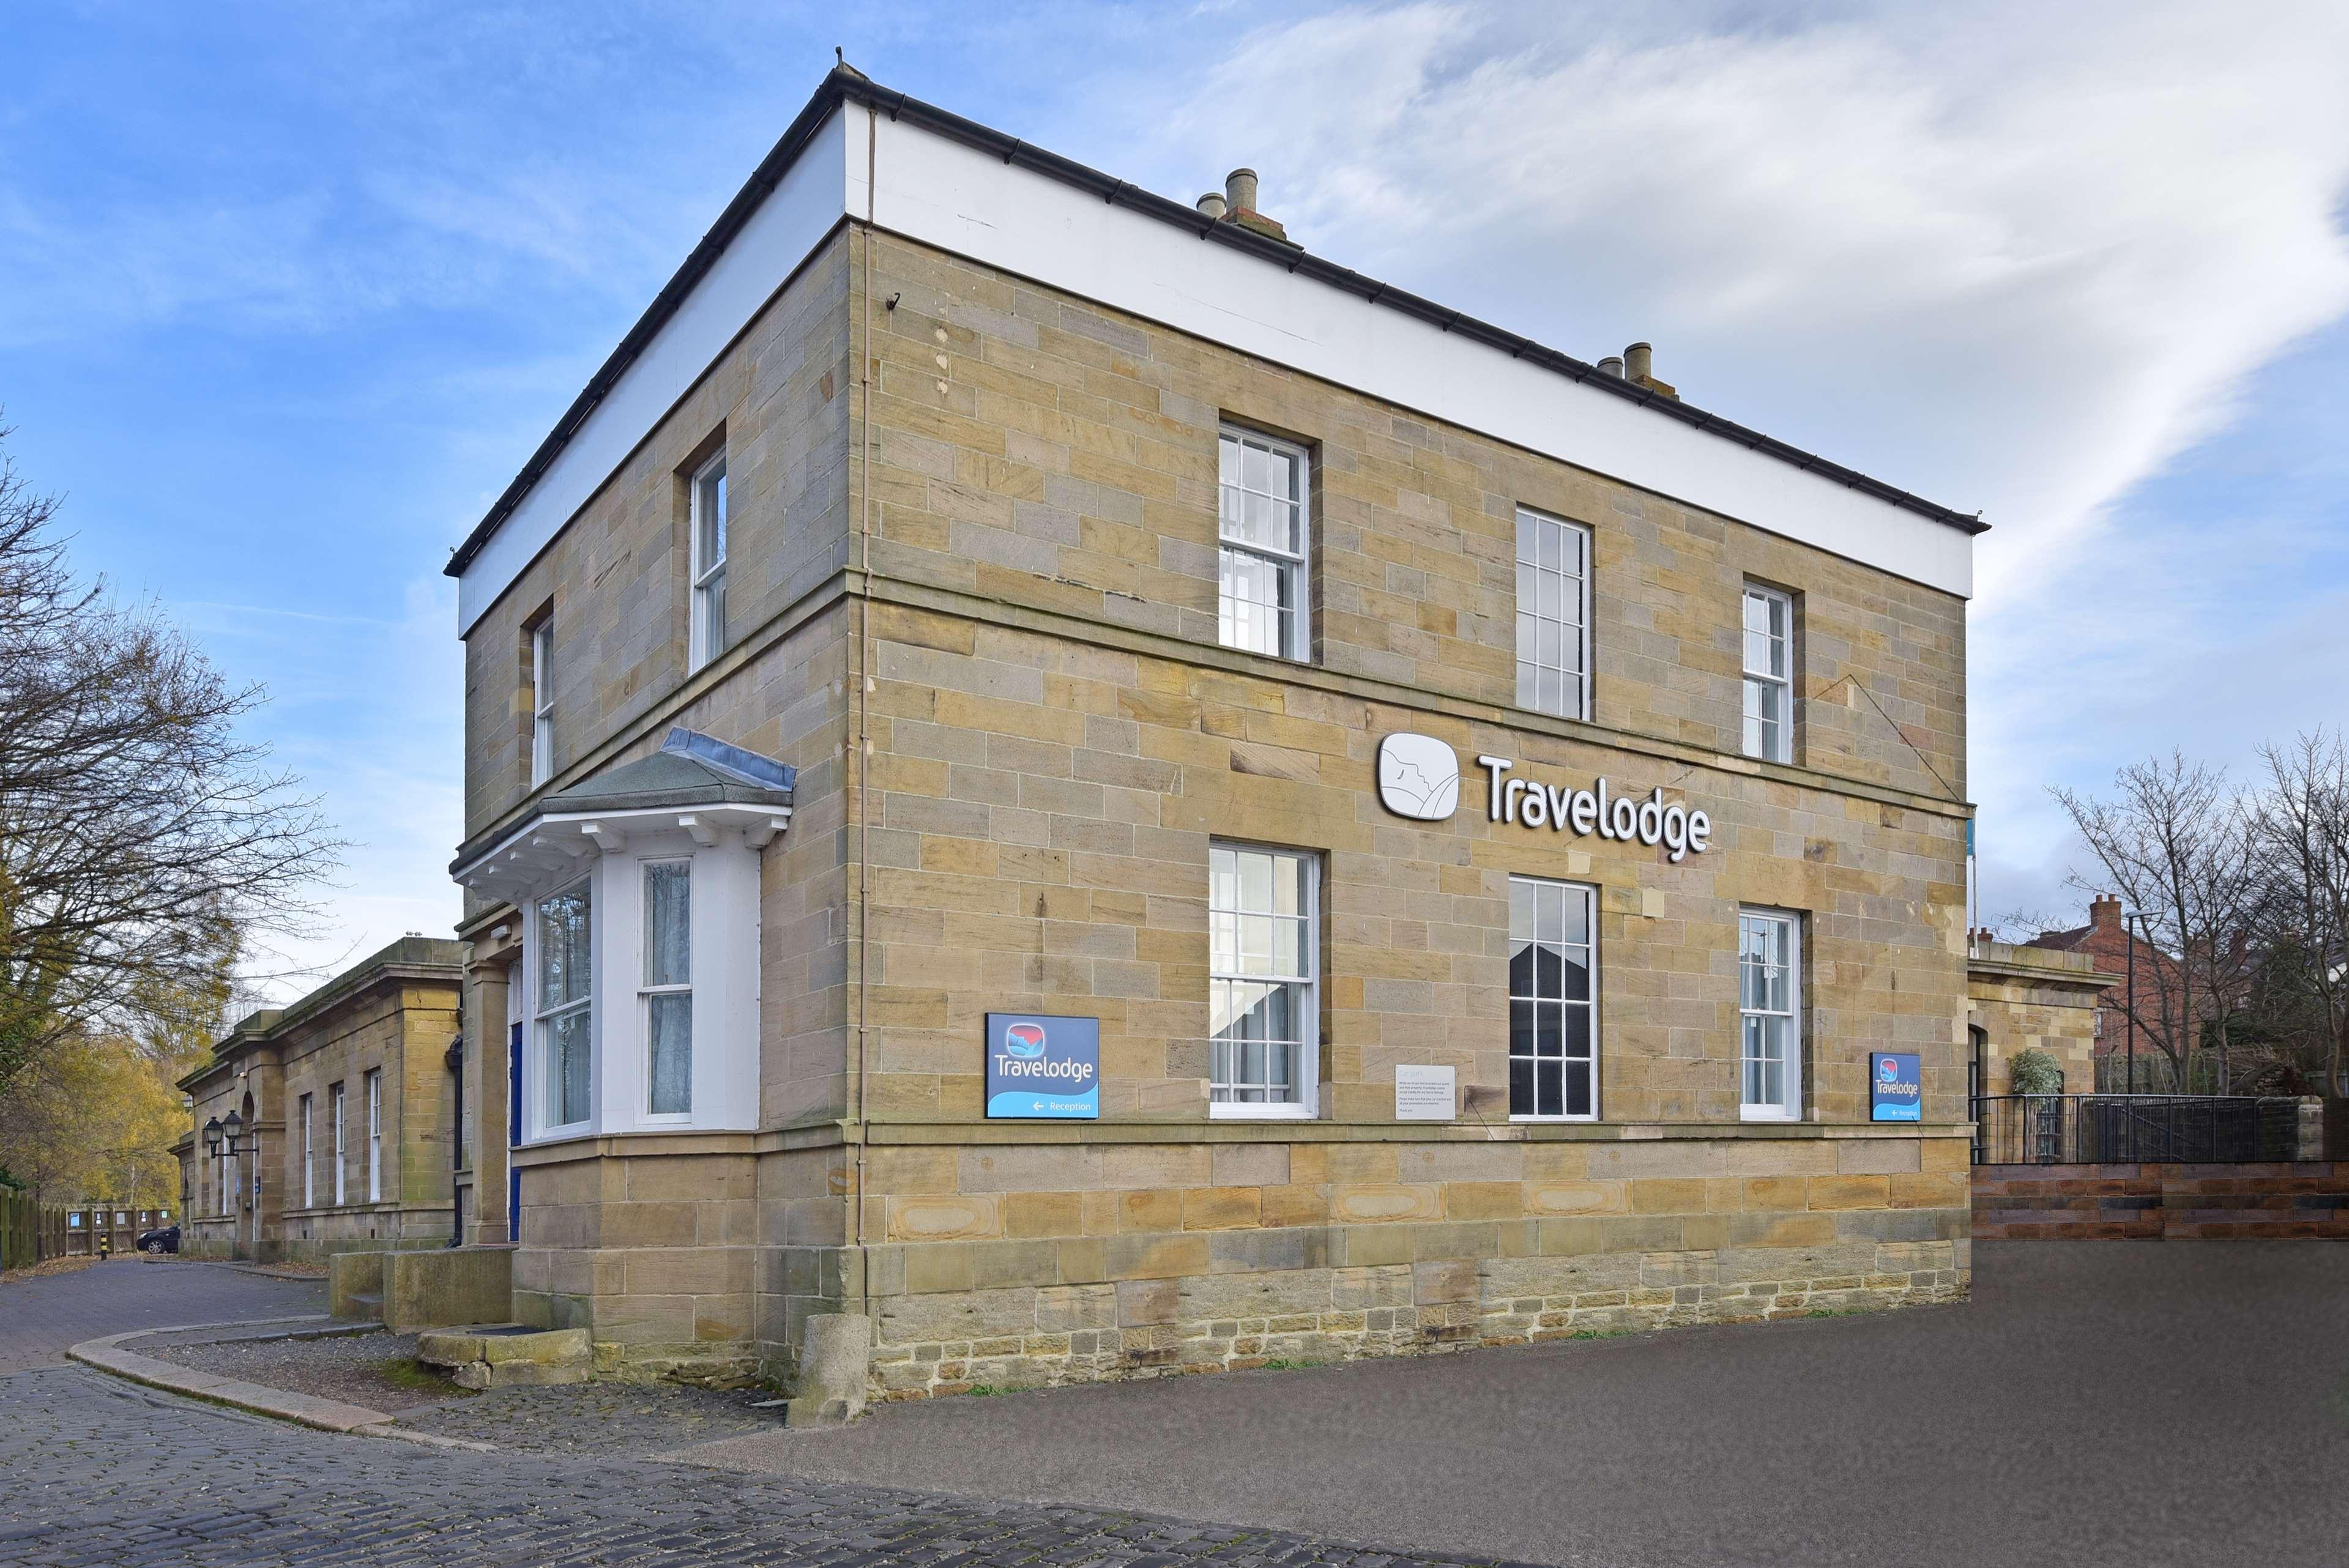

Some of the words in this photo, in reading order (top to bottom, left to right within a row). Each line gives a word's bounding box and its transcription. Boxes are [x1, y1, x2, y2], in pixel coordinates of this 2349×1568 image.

[1478, 755, 1711, 863] Travelodge
[994, 1055, 1093, 1083] Travelodge
[1875, 1080, 1918, 1098] Travelodge
[1050, 1102, 1091, 1113] Reception
